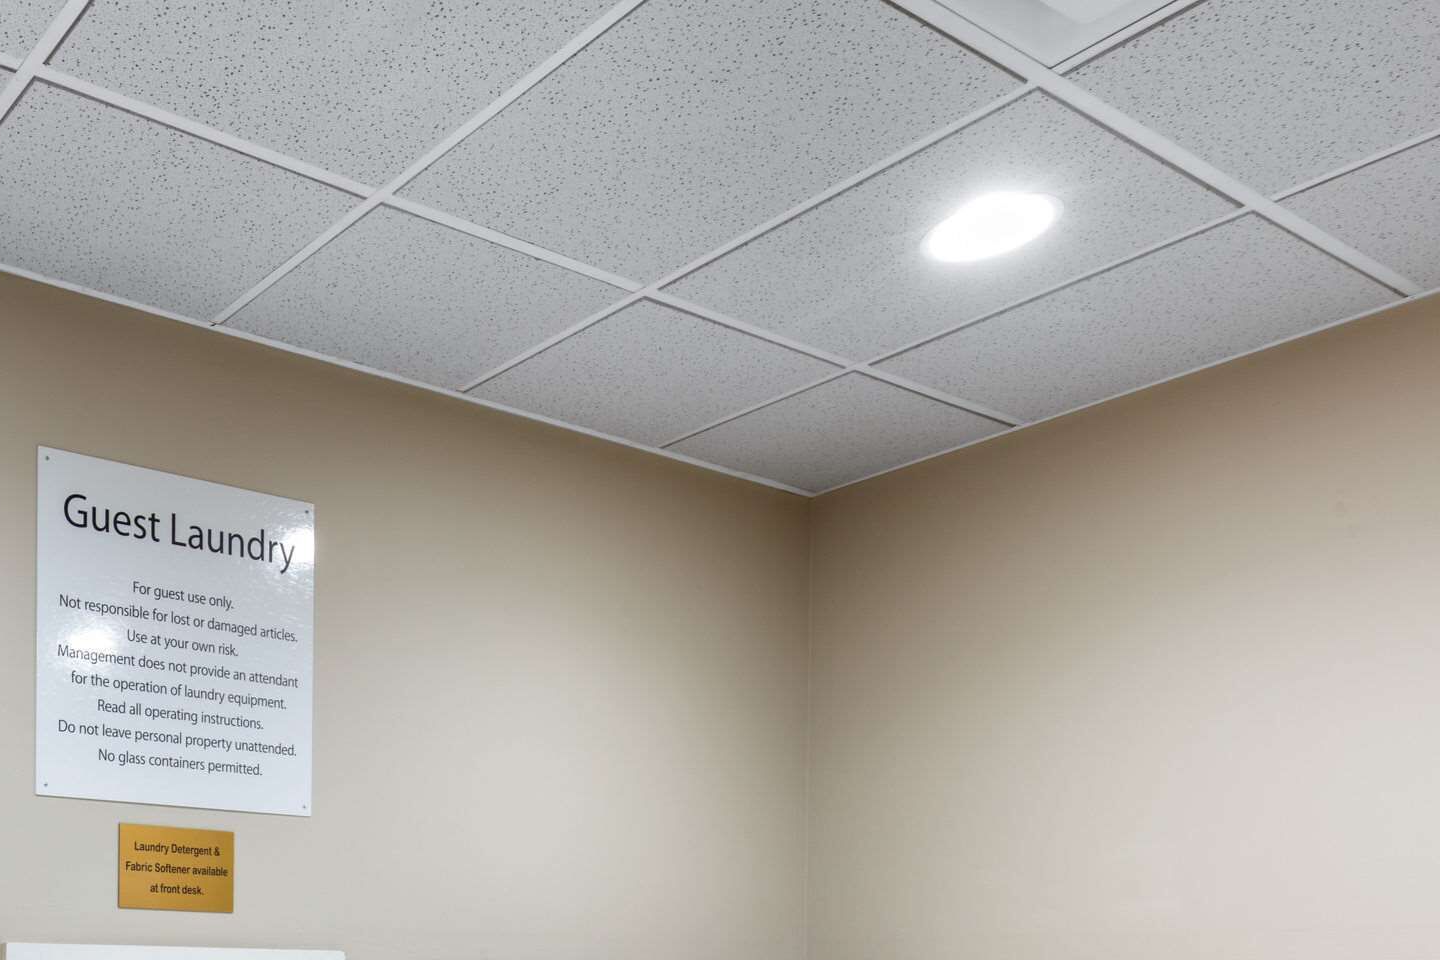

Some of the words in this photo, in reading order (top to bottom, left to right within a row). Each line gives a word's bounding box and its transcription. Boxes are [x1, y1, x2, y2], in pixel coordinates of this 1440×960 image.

[64, 494, 160, 542] Guest
[171, 513, 295, 574] Laundry
[133, 581, 151, 595] For
[154, 586, 184, 601] guest
[188, 593, 206, 603] use
[210, 594, 234, 612] only.
[60, 594, 81, 609] Not
[84, 599, 149, 620] responsible
[153, 609, 168, 622] for
[171, 611, 190, 626] lost
[193, 617, 205, 627] or
[208, 618, 257, 637] damaged
[260, 626, 298, 641] articles.
[128, 629, 148, 644] Use
[150, 634, 161, 645] at
[164, 637, 188, 650] your
[192, 642, 215, 652] own
[219, 642, 239, 656] risk.
[58, 645, 135, 666] Management
[138, 656, 165, 670] does
[168, 662, 187, 673] not
[190, 664, 230, 680] provide
[233, 670, 246, 681] an
[249, 674, 298, 688] attendant
[72, 671, 87, 684] for
[91, 674, 109, 687] the
[113, 679, 167, 695] operation
[171, 684, 183, 695] of
[185, 686, 224, 704] laundry
[228, 693, 287, 709] equipment.
[98, 699, 125, 713] Read
[129, 703, 141, 715] all
[145, 707, 197, 724] operating
[201, 712, 264, 729] instructions.
[58, 720, 75, 733] Do
[79, 725, 98, 736] not
[103, 724, 131, 739] leave
[135, 729, 182, 744] personal
[186, 735, 232, 752] property
[235, 740, 296, 756] unattended.
[98, 749, 115, 762] No
[118, 753, 145, 766] glass
[149, 755, 205, 770] containers
[208, 761, 262, 776] permitted.
[134, 841, 169, 855] Laundry
[171, 844, 212, 857] Detergent
[214, 847, 220, 856] &
[126, 861, 152, 872] Fabric
[155, 863, 190, 874] Softener
[192, 866, 228, 876] available
[150, 885, 158, 893] at
[160, 884, 180, 893] front
[182, 886, 204, 895] desk.
